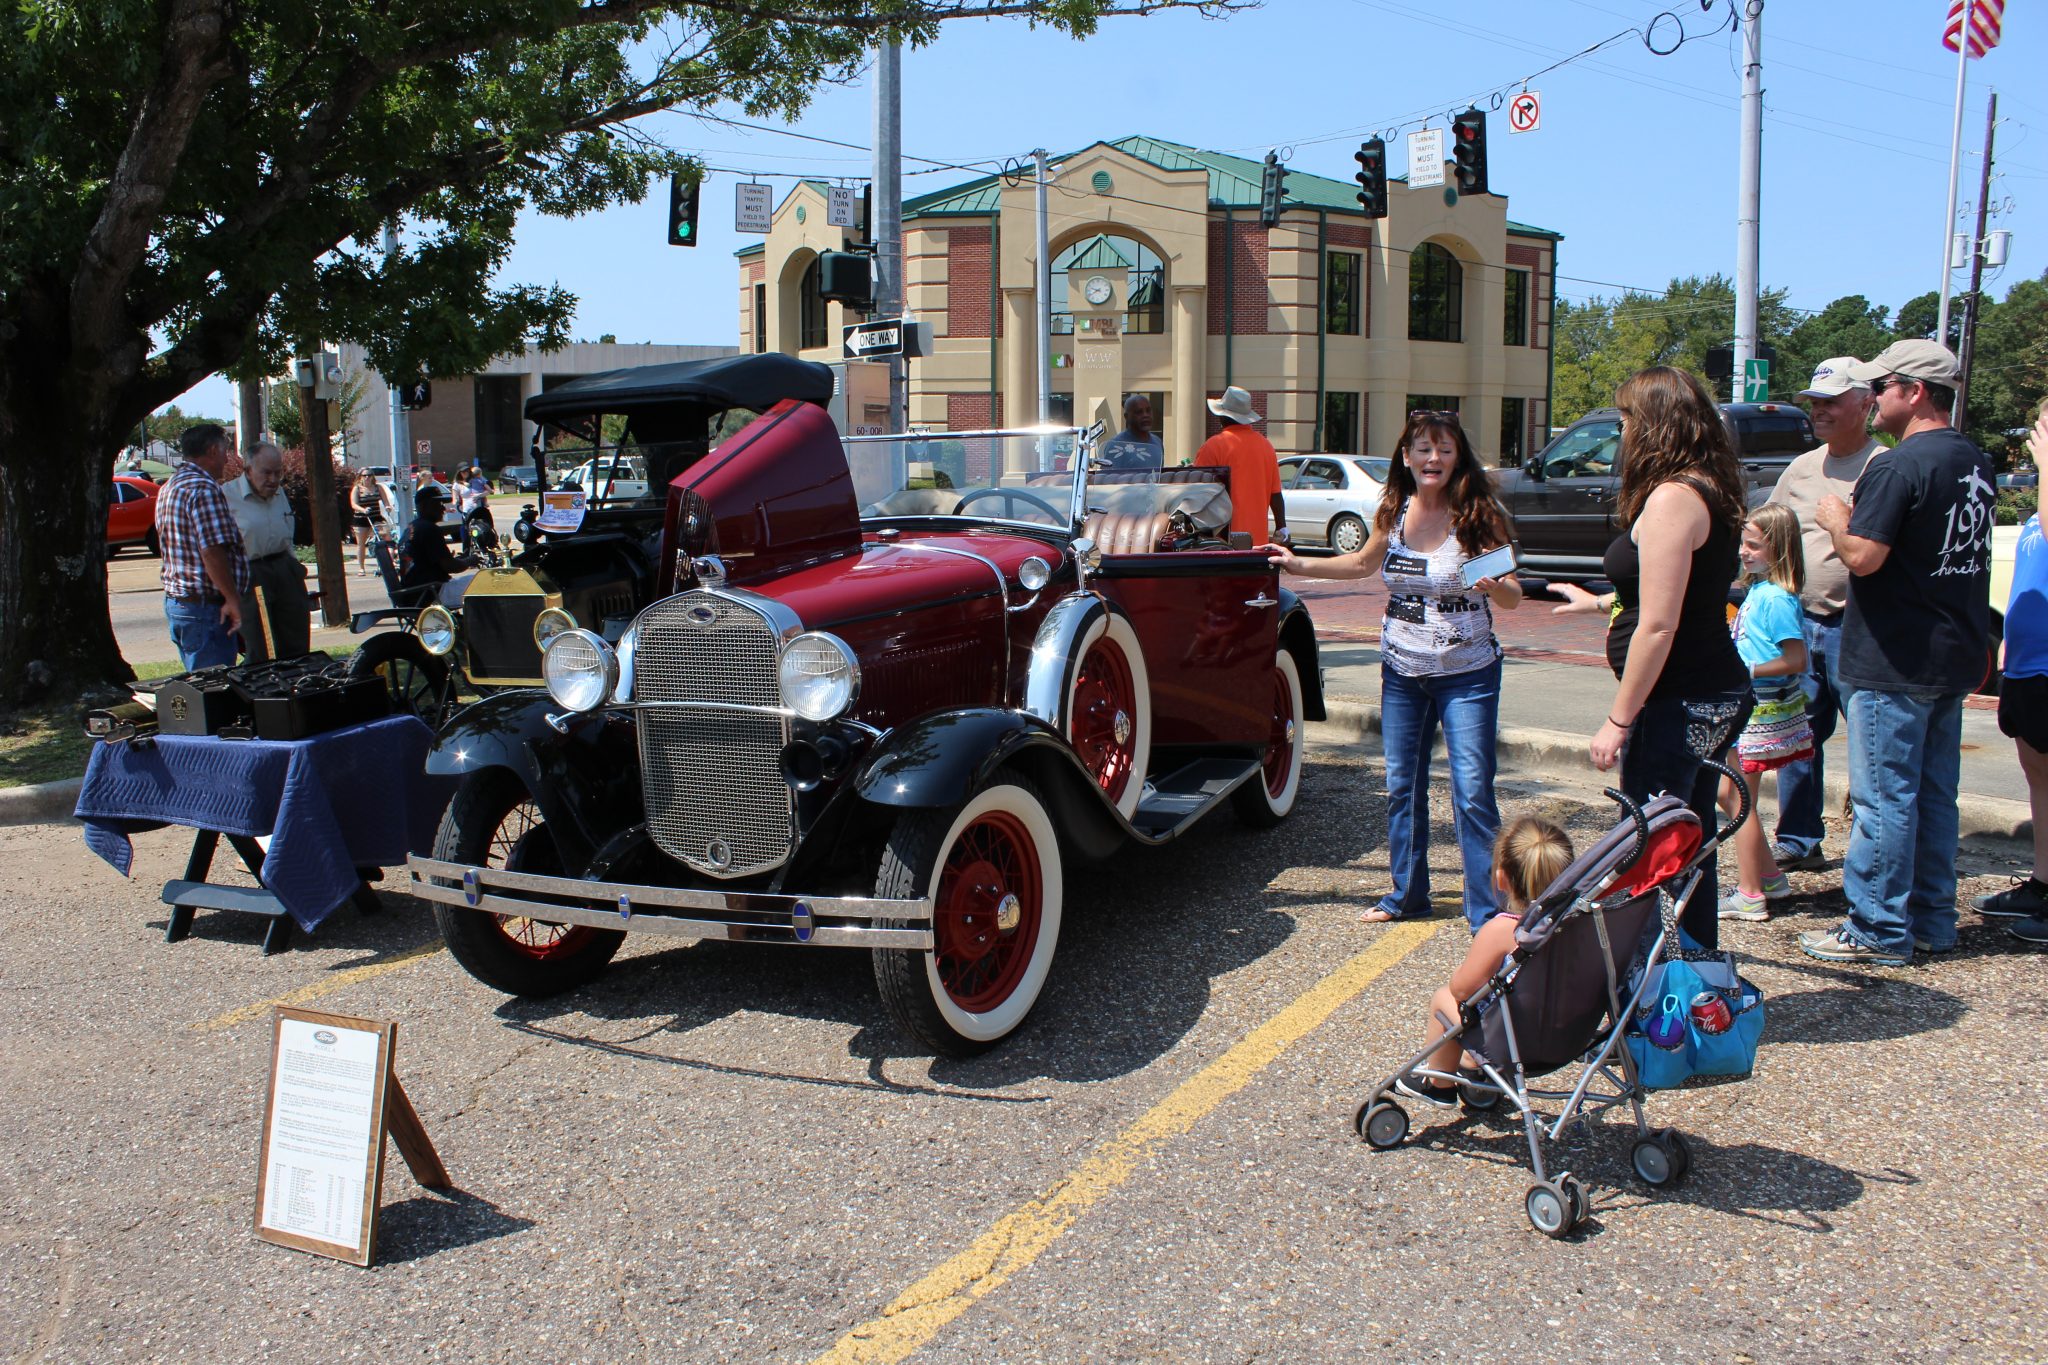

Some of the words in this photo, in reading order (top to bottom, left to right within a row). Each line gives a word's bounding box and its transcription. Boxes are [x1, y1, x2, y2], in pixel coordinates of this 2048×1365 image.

[1417, 154, 1434, 162] MUST
[1415, 165, 1430, 173] YIELD
[1410, 173, 1443, 182] PEDESTRIANS
[835, 191, 848, 199] NO
[833, 200, 849, 208] TURN
[859, 333, 876, 347] ONE
[878, 330, 896, 345] WAY
